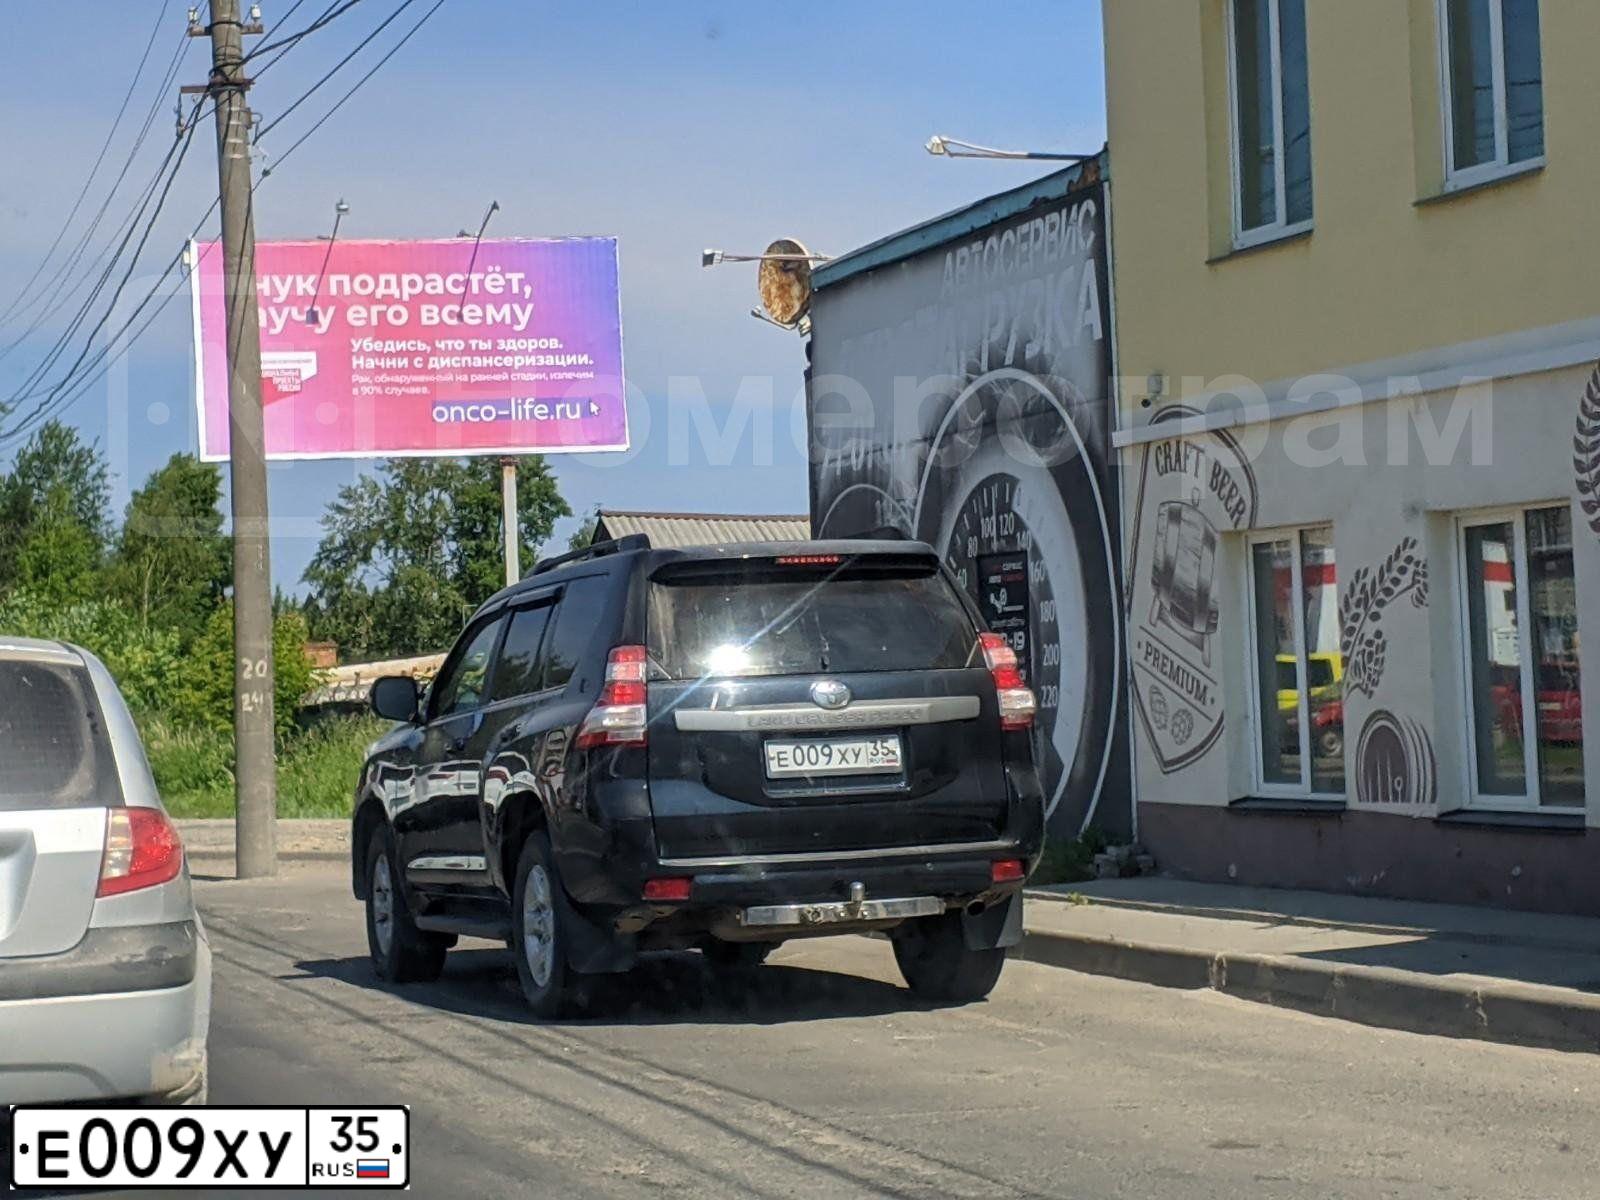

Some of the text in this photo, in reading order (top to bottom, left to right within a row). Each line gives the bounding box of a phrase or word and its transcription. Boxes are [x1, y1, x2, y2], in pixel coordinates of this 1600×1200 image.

[256, 265, 533, 303] нук подрастёт,
[346, 303, 409, 327] его
[420, 303, 535, 332] всему
[350, 336, 564, 354] Убедись, что ты здоров.
[351, 353, 595, 371] Начни с диспансеризации.
[360, 385, 383, 396] 90%
[432, 397, 582, 423] onco-life.ru
[1154, 439, 1247, 529] CRAFT BEER
[999, 511, 1015, 536] 120
[967, 535, 978, 559] 80
[1040, 600, 1056, 623] 180
[1043, 644, 1059, 667] 200
[241, 657, 268, 680] 20
[1143, 641, 1209, 706] PREMIUM
[1041, 684, 1058, 708] 220
[868, 739, 892, 758] 35
